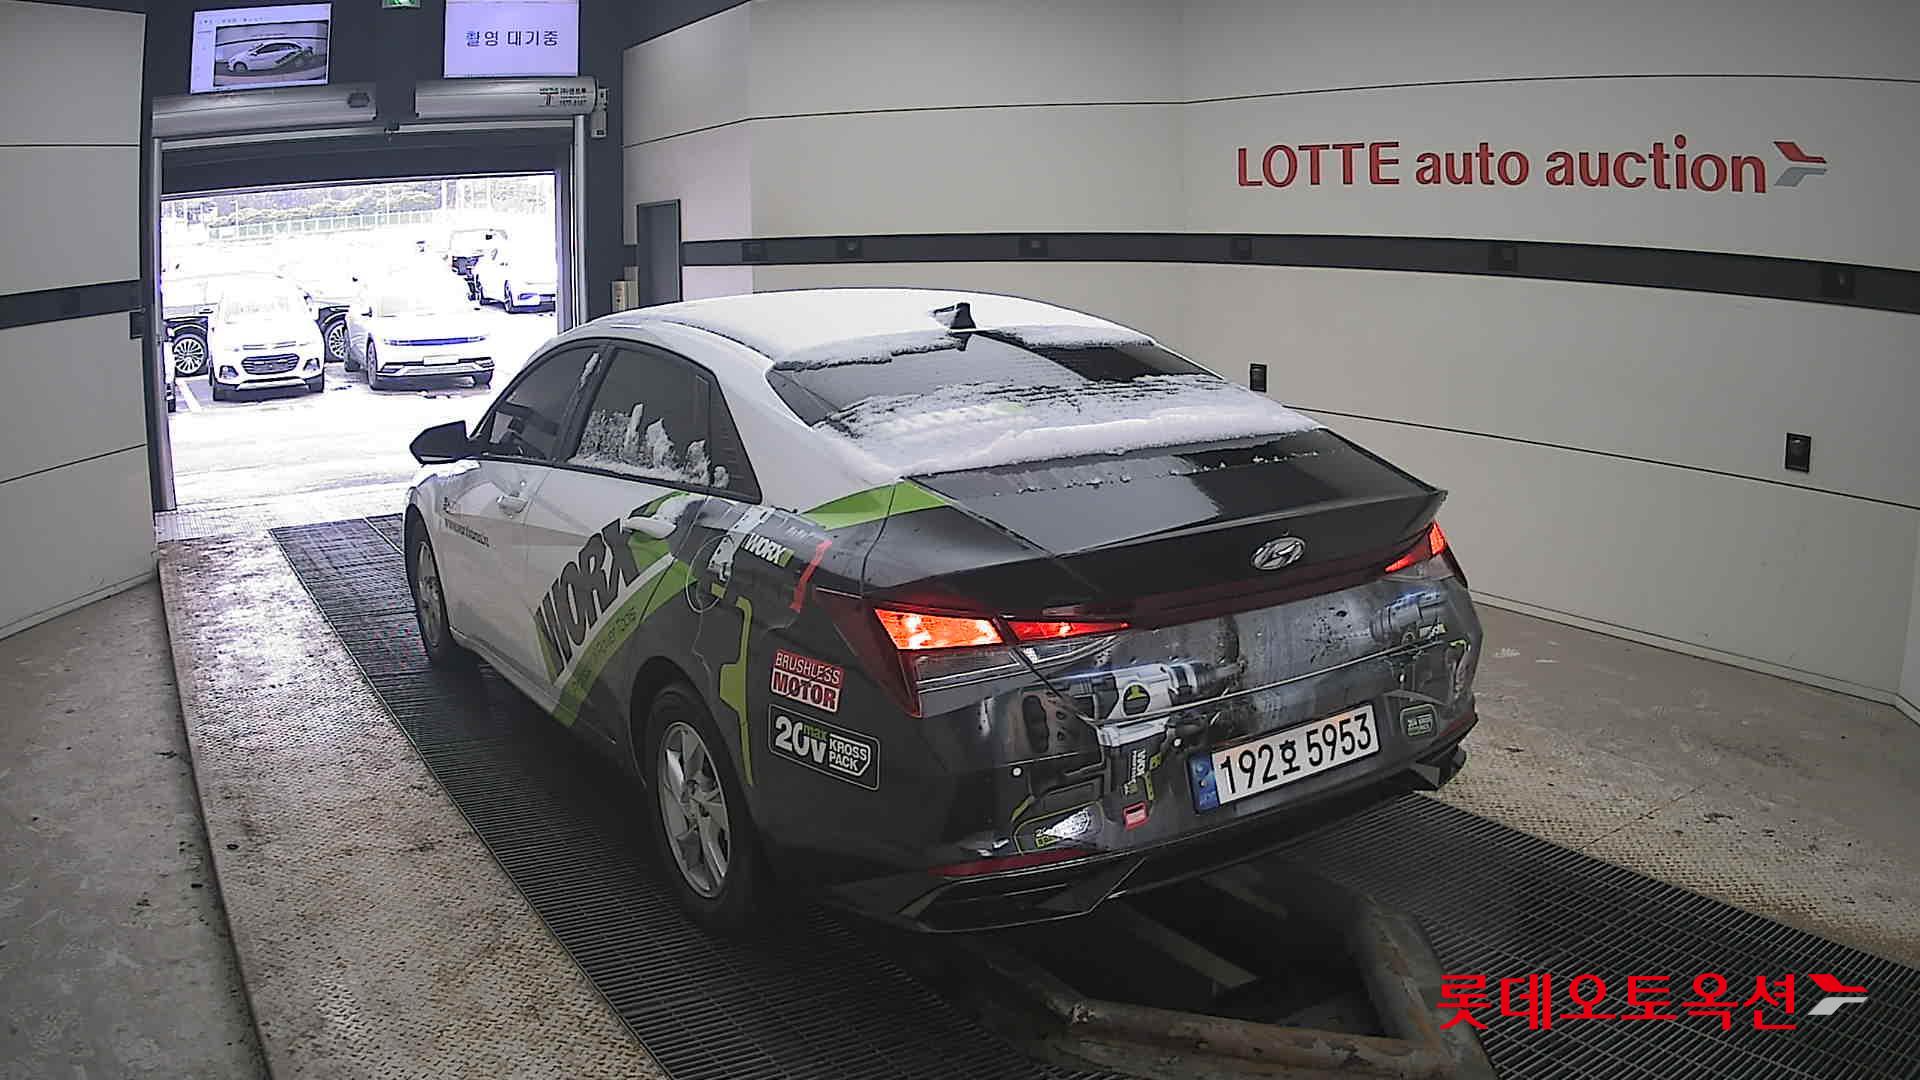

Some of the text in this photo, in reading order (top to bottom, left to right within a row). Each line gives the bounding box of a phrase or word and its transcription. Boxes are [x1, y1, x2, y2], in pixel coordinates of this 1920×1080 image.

[507, 30, 559, 47] 대기중
[1237, 134, 1767, 194] LOTTE auto auction
[743, 533, 786, 564] WORX
[532, 518, 641, 678] WORX
[775, 652, 841, 684] BRUSHLESS
[773, 671, 837, 709] MOTOR
[829, 738, 867, 760] KROSS
[829, 751, 858, 770] PACK
[1220, 740, 1301, 794] 192호
[1306, 713, 1371, 767] 5953
